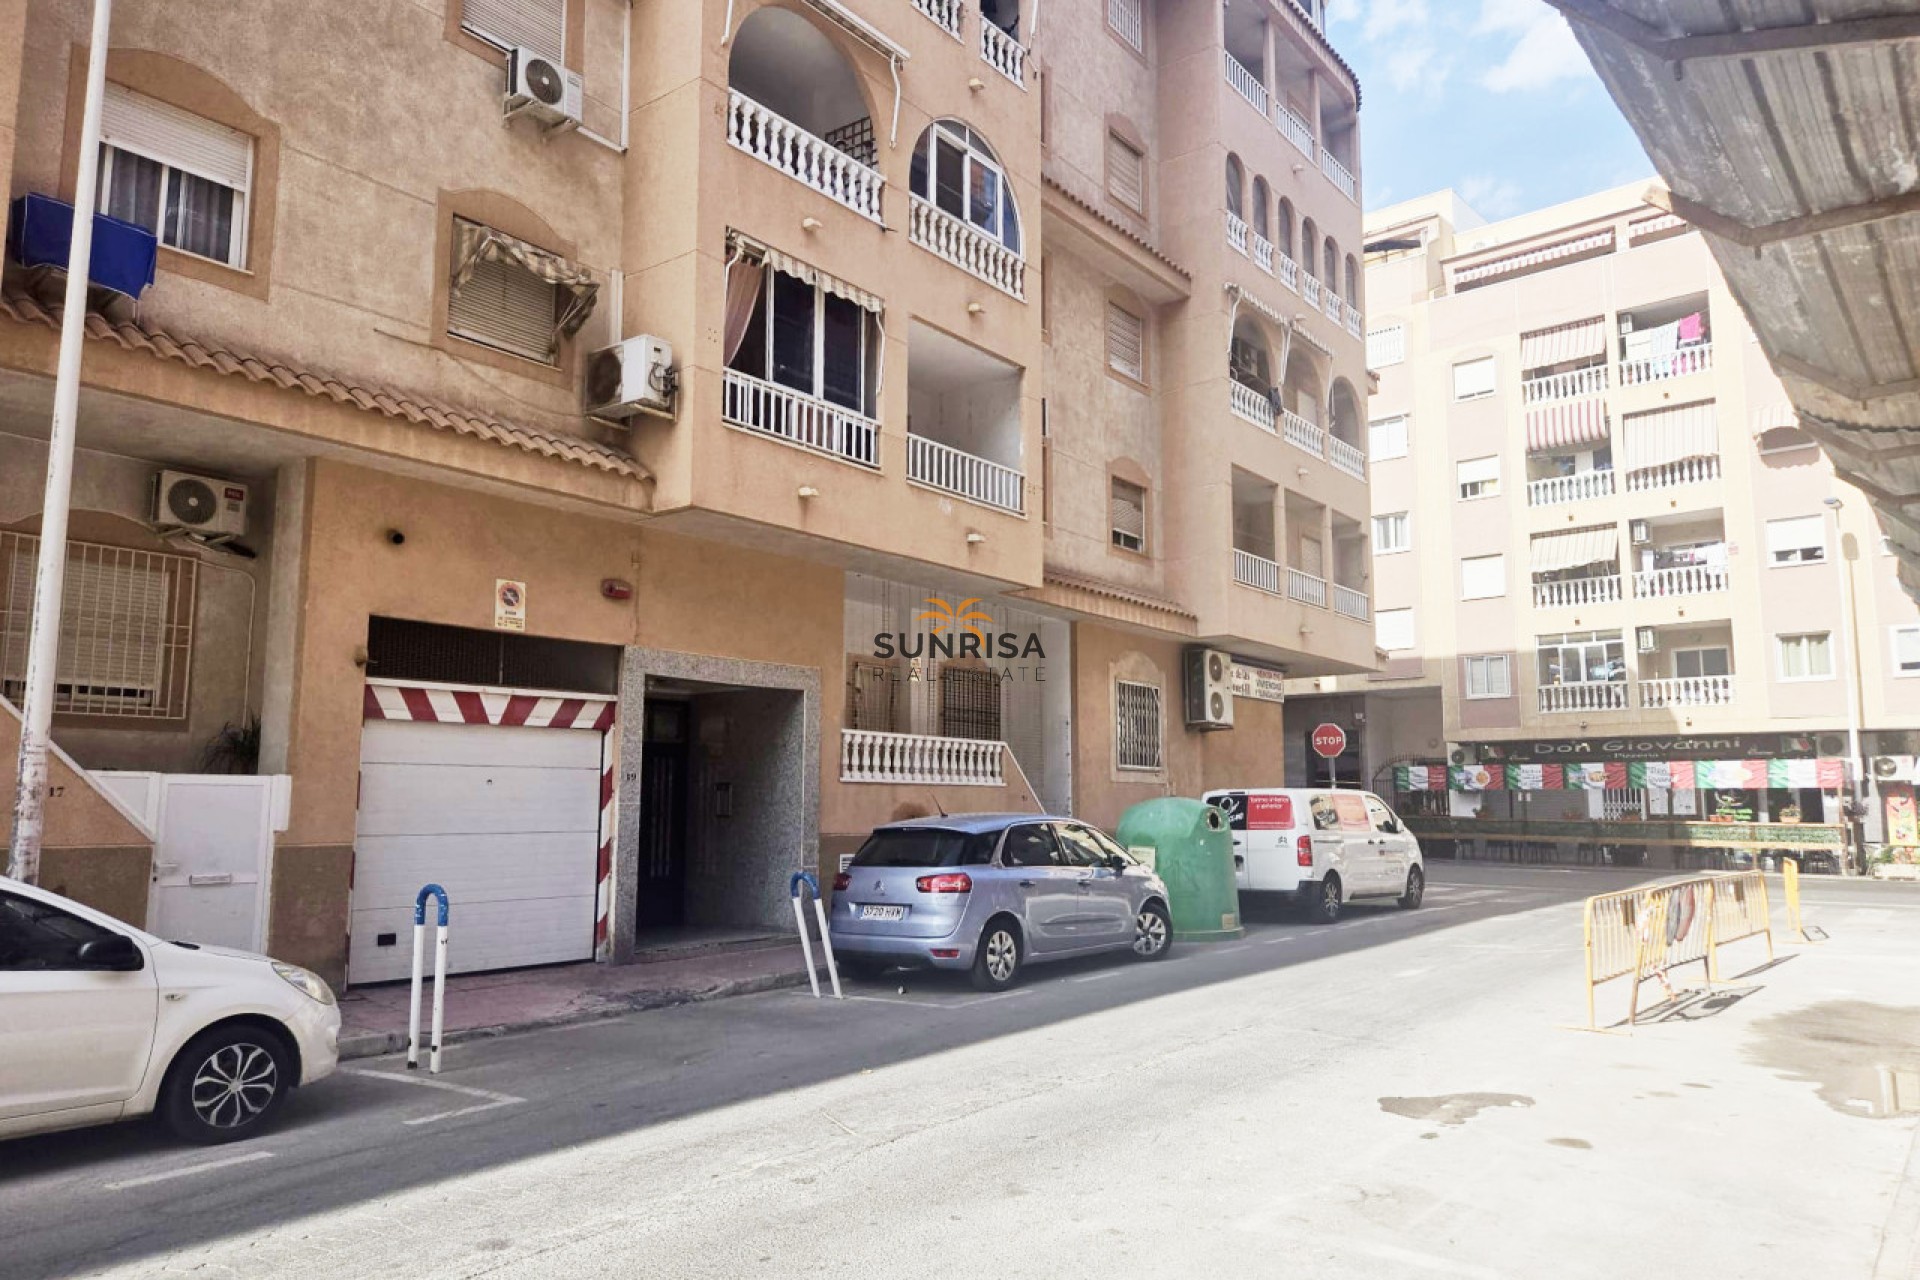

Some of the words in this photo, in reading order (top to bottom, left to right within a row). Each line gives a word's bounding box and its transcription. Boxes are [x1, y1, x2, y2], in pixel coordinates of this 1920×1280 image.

[1316, 736, 1342, 745] STOP
[1534, 741, 1591, 754] Don
[1602, 738, 1740, 751] Giovanni
[50, 787, 65, 798] 17
